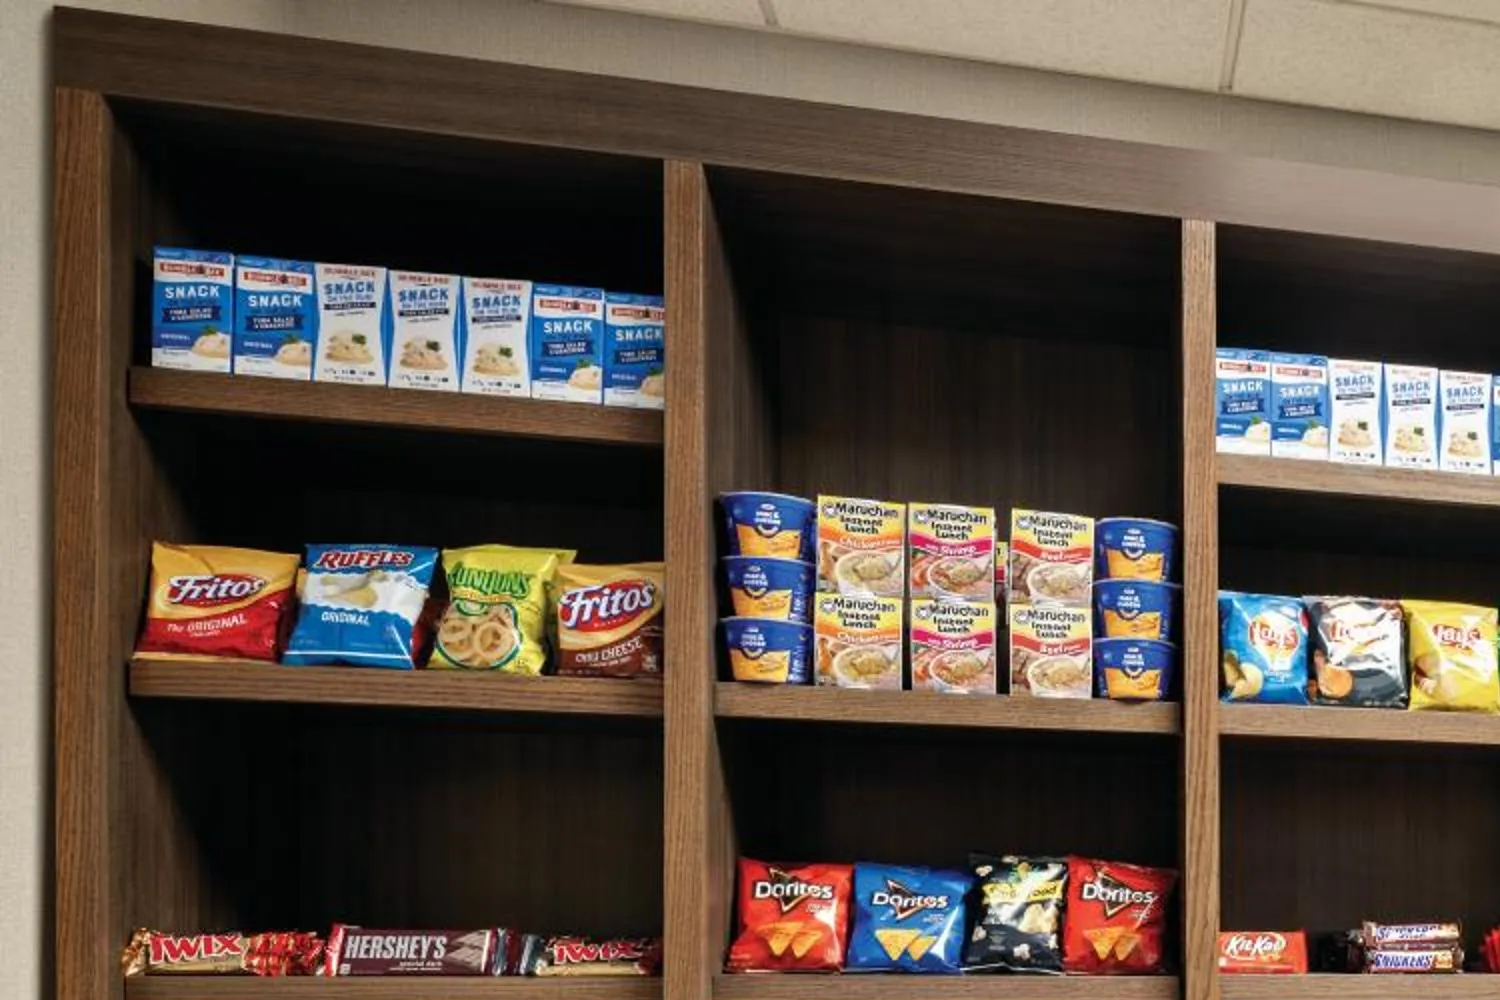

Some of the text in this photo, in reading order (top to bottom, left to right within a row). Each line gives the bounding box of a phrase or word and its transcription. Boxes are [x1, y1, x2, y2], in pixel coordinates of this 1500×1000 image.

[164, 285, 220, 299] SNACK
[323, 280, 375, 295] SNACK
[398, 287, 449, 302] SNACK
[248, 293, 303, 308] SNACK
[471, 295, 521, 309] SNACK
[543, 320, 593, 334] SNACK
[615, 328, 663, 342] SNACK
[1223, 380, 1264, 393] SNACK
[1335, 374, 1375, 388] SNACK
[1391, 380, 1431, 393] SNACK
[1279, 385, 1320, 399] SNACK
[1446, 386, 1485, 398] SNACK
[835, 502, 898, 517] Maruchan
[926, 508, 987, 524] Maruchan
[845, 524, 879, 535] Lunch
[1029, 515, 1087, 532] Maruchan
[935, 530, 969, 540] Lunch
[1037, 536, 1070, 547] Lunch
[316, 550, 415, 570] RUFFLES
[557, 578, 656, 628] Fritos
[834, 598, 896, 613] Maruchan
[928, 603, 989, 617] Maruchan
[321, 611, 371, 626] ORIGINAL
[1027, 608, 1086, 623] Maruchan
[187, 614, 248, 633] ORIGINAL
[843, 618, 877, 629] Lunch
[937, 624, 970, 633] Lunch
[1035, 629, 1068, 639] Lunch
[600, 635, 644, 661] CHEESE
[754, 880, 834, 900] Doritos
[1082, 881, 1154, 904] Doritos
[872, 891, 950, 909] Doritos
[149, 932, 242, 965] TWIX
[344, 935, 448, 959] HERSHEY'S
